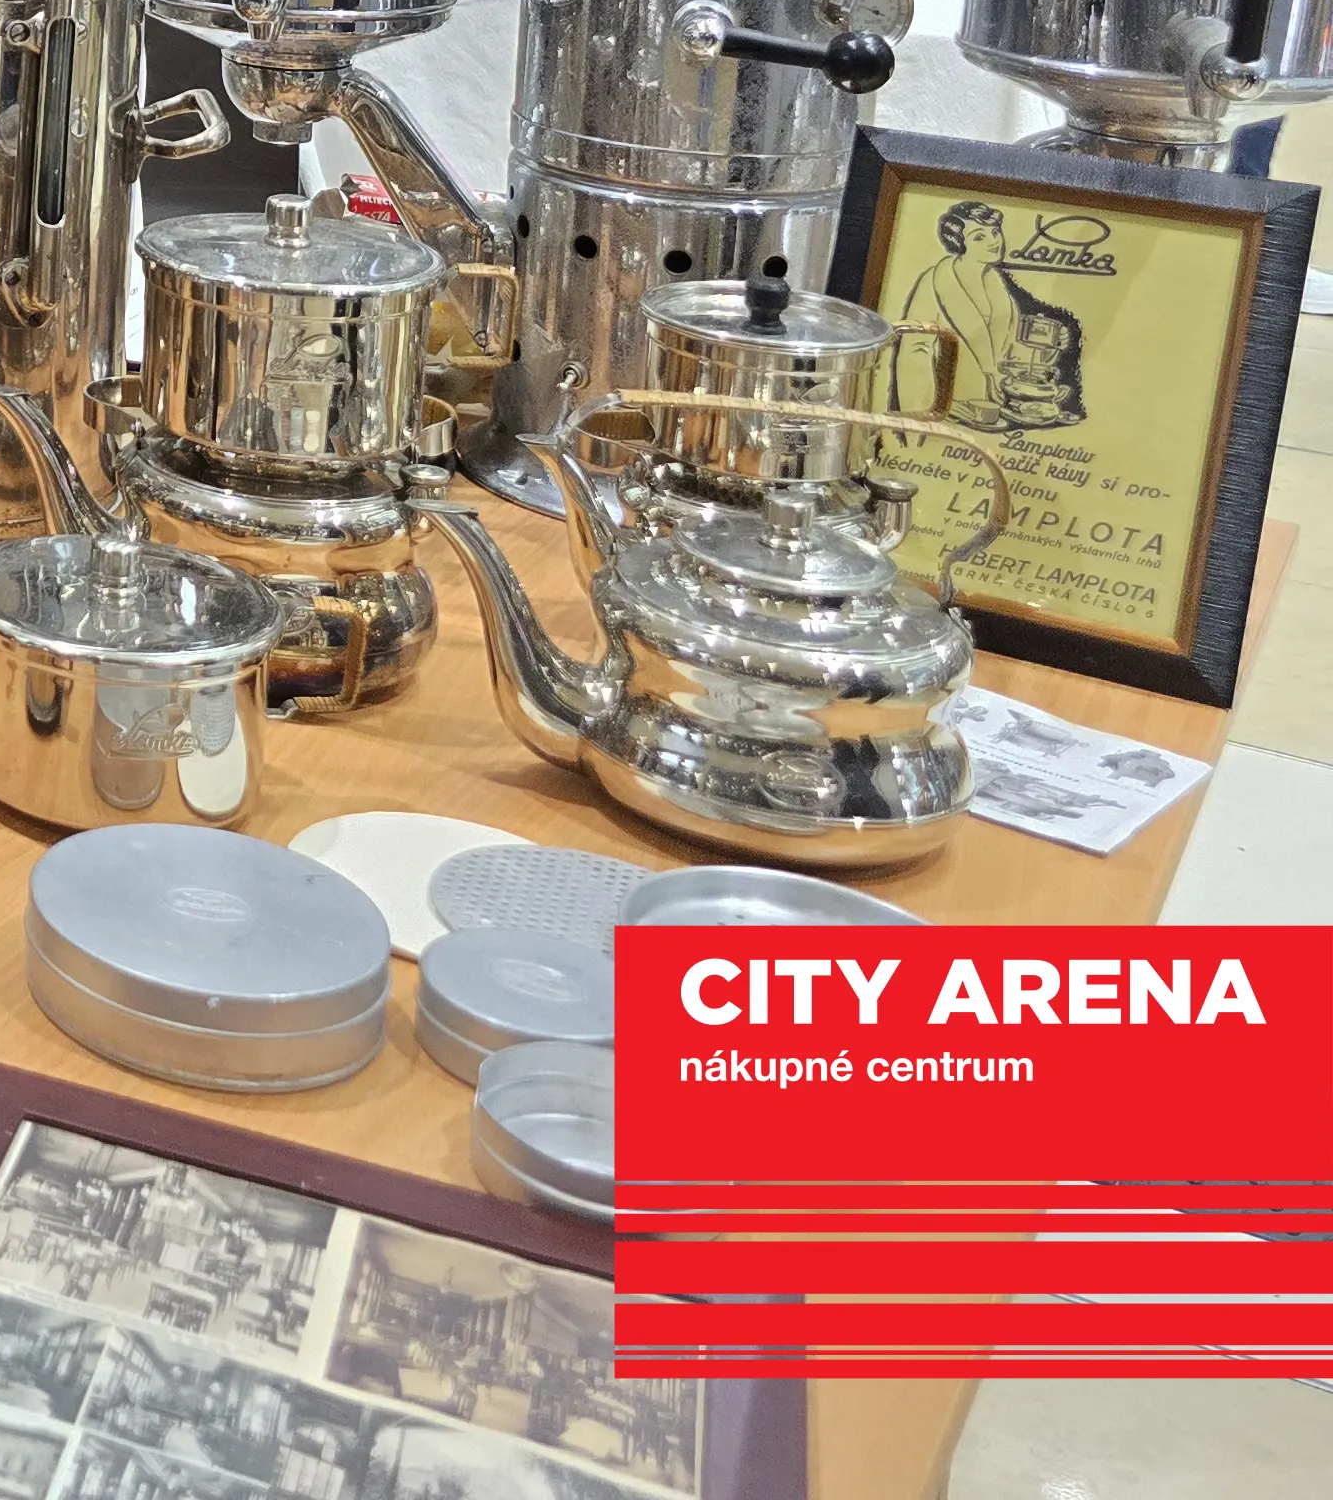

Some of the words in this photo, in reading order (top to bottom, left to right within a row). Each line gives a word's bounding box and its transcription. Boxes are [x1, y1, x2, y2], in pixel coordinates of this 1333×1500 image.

[1009, 214, 1118, 276] Lamka
[957, 472, 969, 484] v
[1045, 460, 1091, 489] kávy
[1100, 476, 1118, 492] si
[1124, 481, 1172, 501] pro-
[937, 542, 1032, 577] HBERT
[1034, 563, 1158, 605] LAMPLOTA
